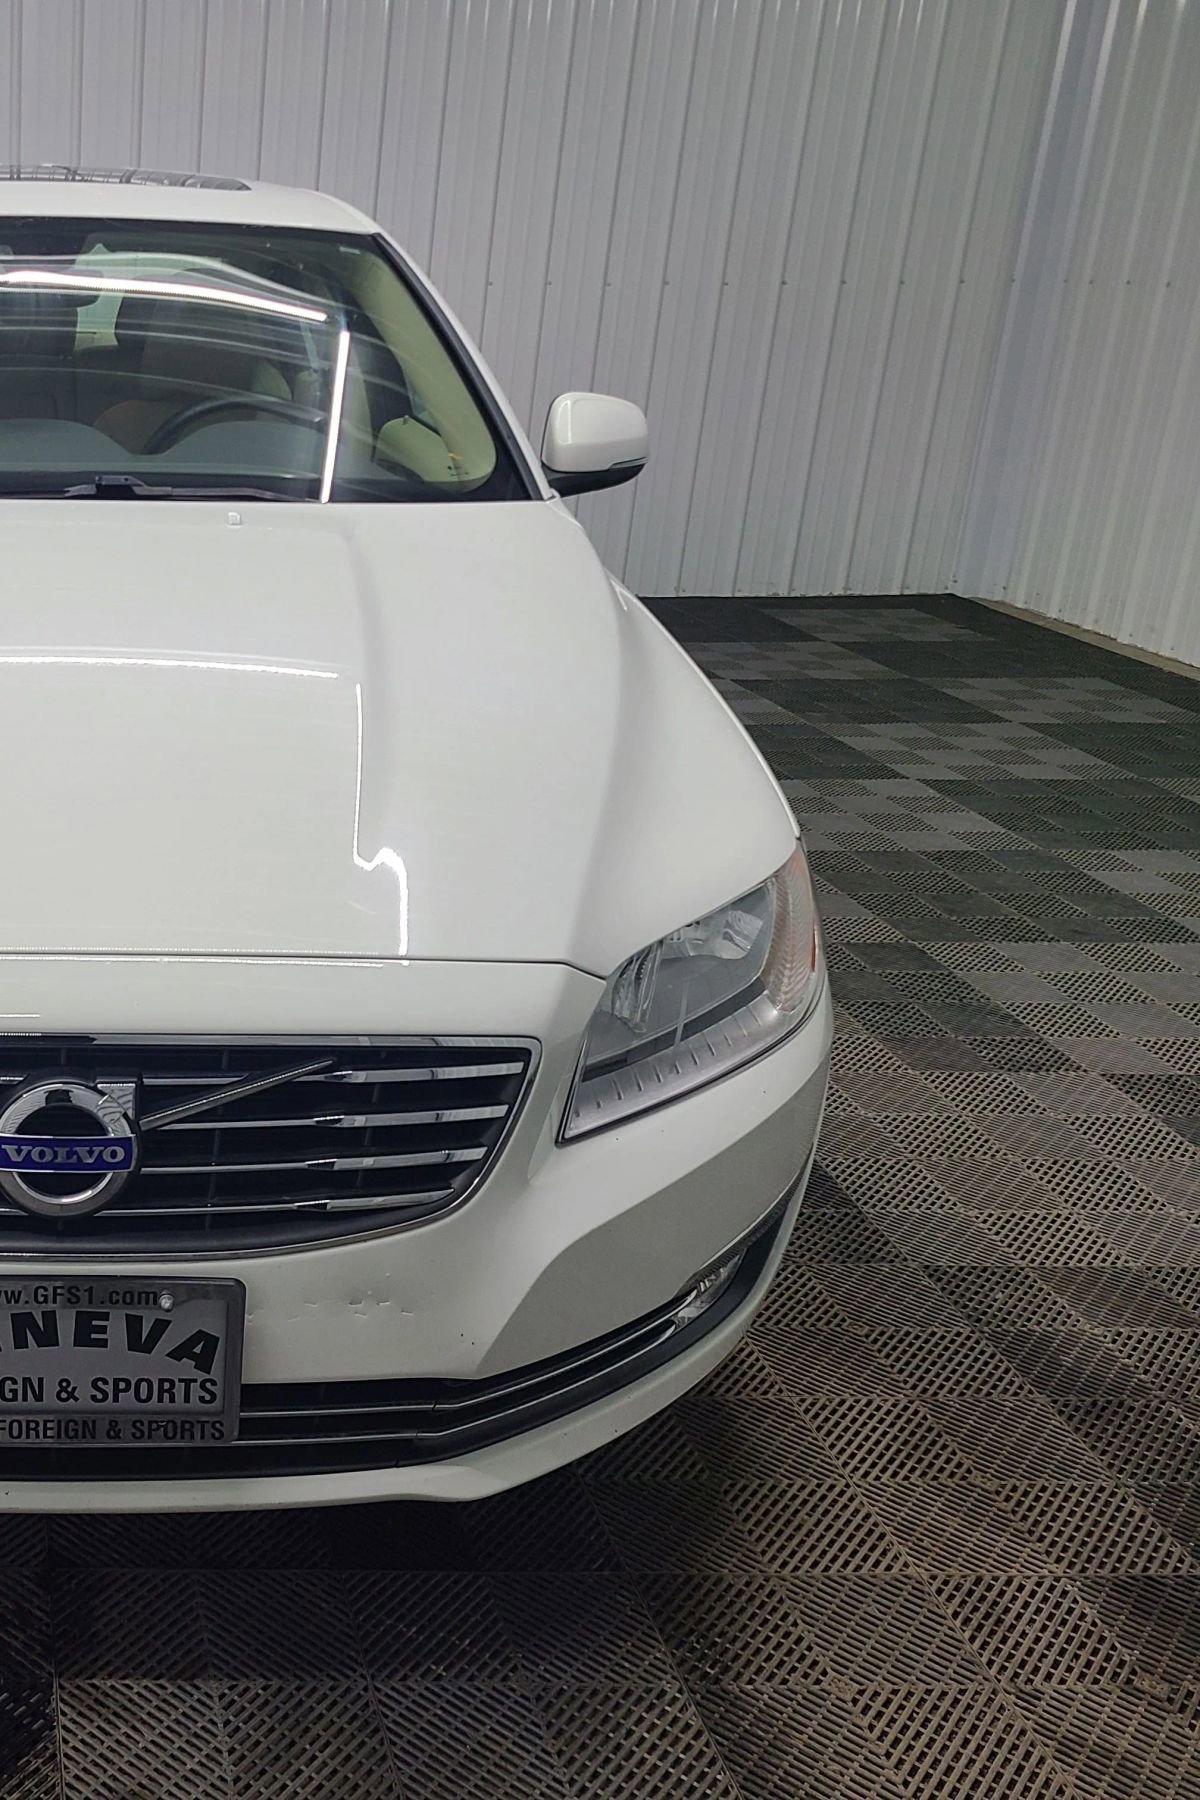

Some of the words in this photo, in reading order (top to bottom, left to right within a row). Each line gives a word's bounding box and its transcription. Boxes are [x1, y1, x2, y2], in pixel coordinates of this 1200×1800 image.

[1, 1144, 125, 1163] VOLVO
[55, 1378, 80, 1404] &
[90, 1377, 218, 1404] SPORTS
[105, 1420, 122, 1441] &
[131, 1420, 225, 1441] SPORTS
